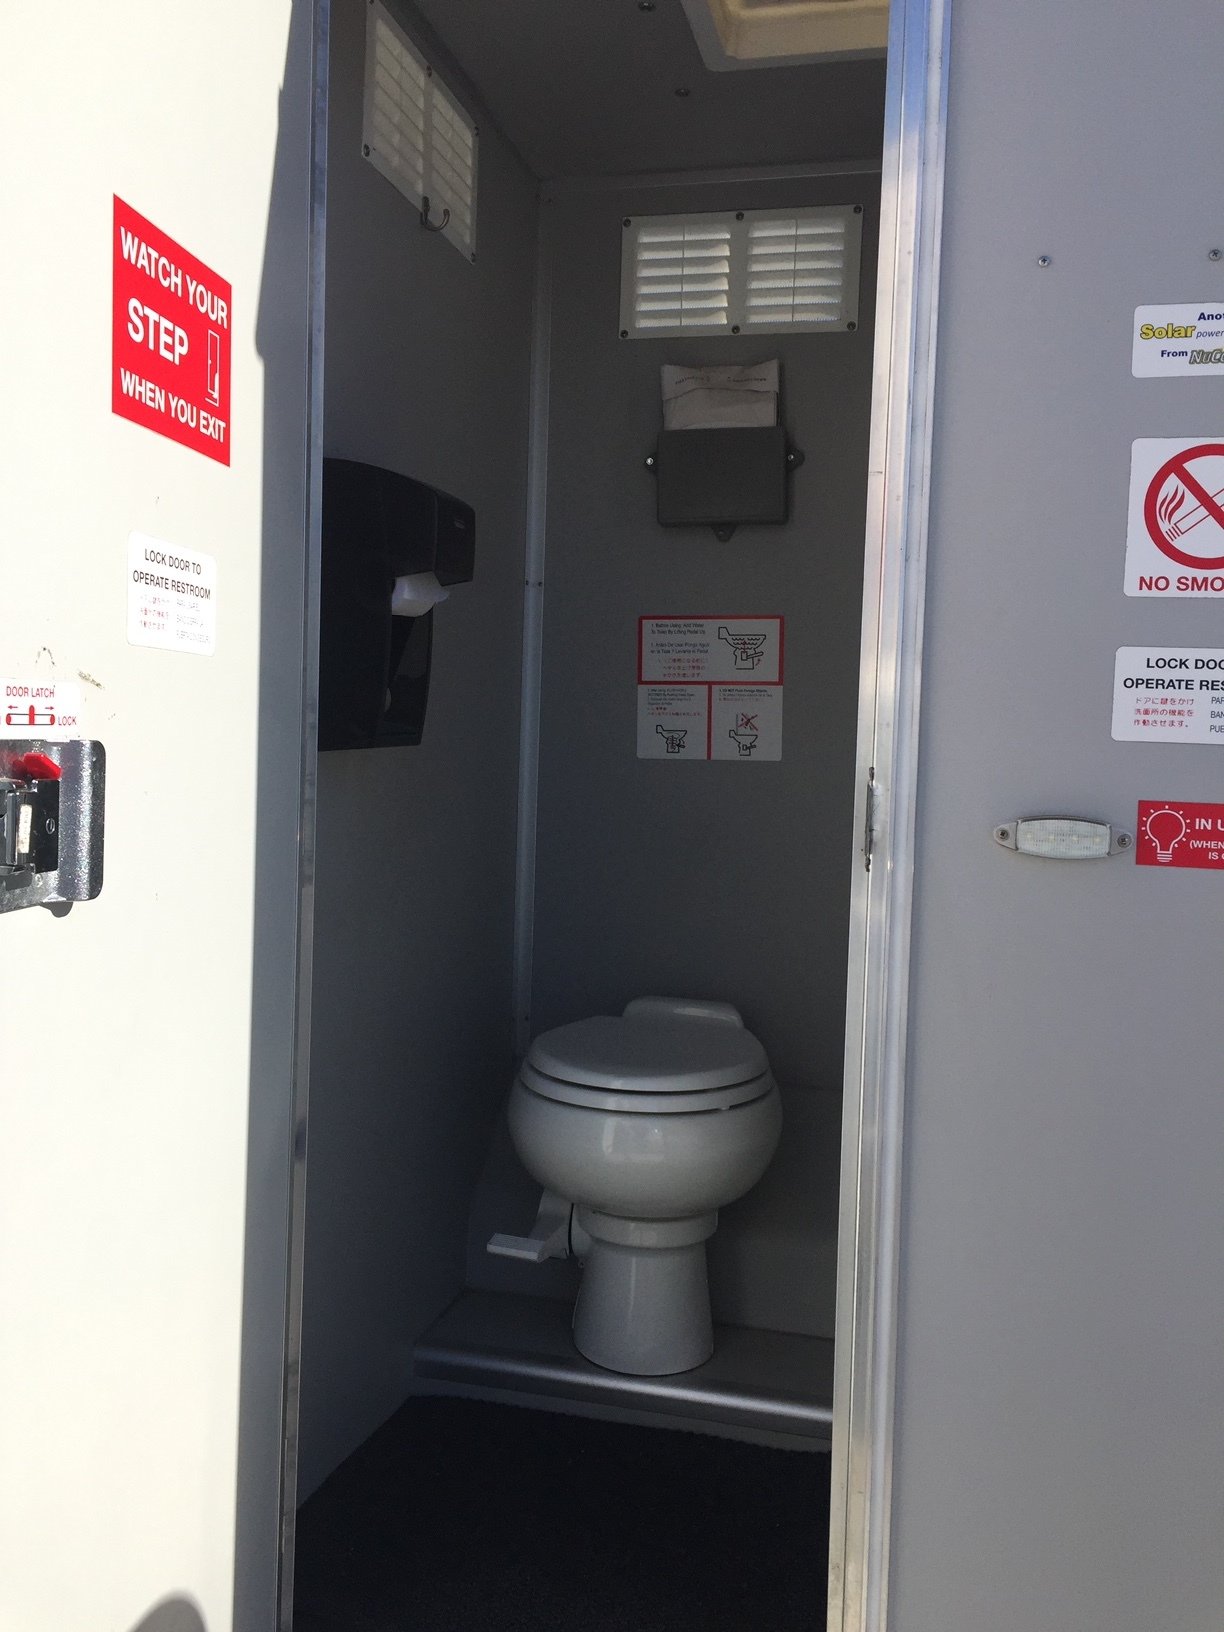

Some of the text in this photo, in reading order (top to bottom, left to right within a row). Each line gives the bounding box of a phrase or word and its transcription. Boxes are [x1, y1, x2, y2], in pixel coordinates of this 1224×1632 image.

[120, 226, 228, 329] WATCH YOUR
[127, 297, 190, 366] STEP
[1140, 323, 1196, 340] Solar
[120, 367, 226, 443] WHEN YOU EXIT
[144, 548, 202, 575] LOCK DOOR TO
[133, 570, 211, 600] OPERATE RESTROOM
[1138, 576, 1170, 591] NO
[1146, 658, 1189, 669] LOCK
[1123, 677, 1194, 690] OPERATE
[6, 686, 55, 698] DOOR LATCH
[58, 716, 77, 726] LOCK
[1195, 818, 1212, 830] IN
[1208, 851, 1219, 860] IS
